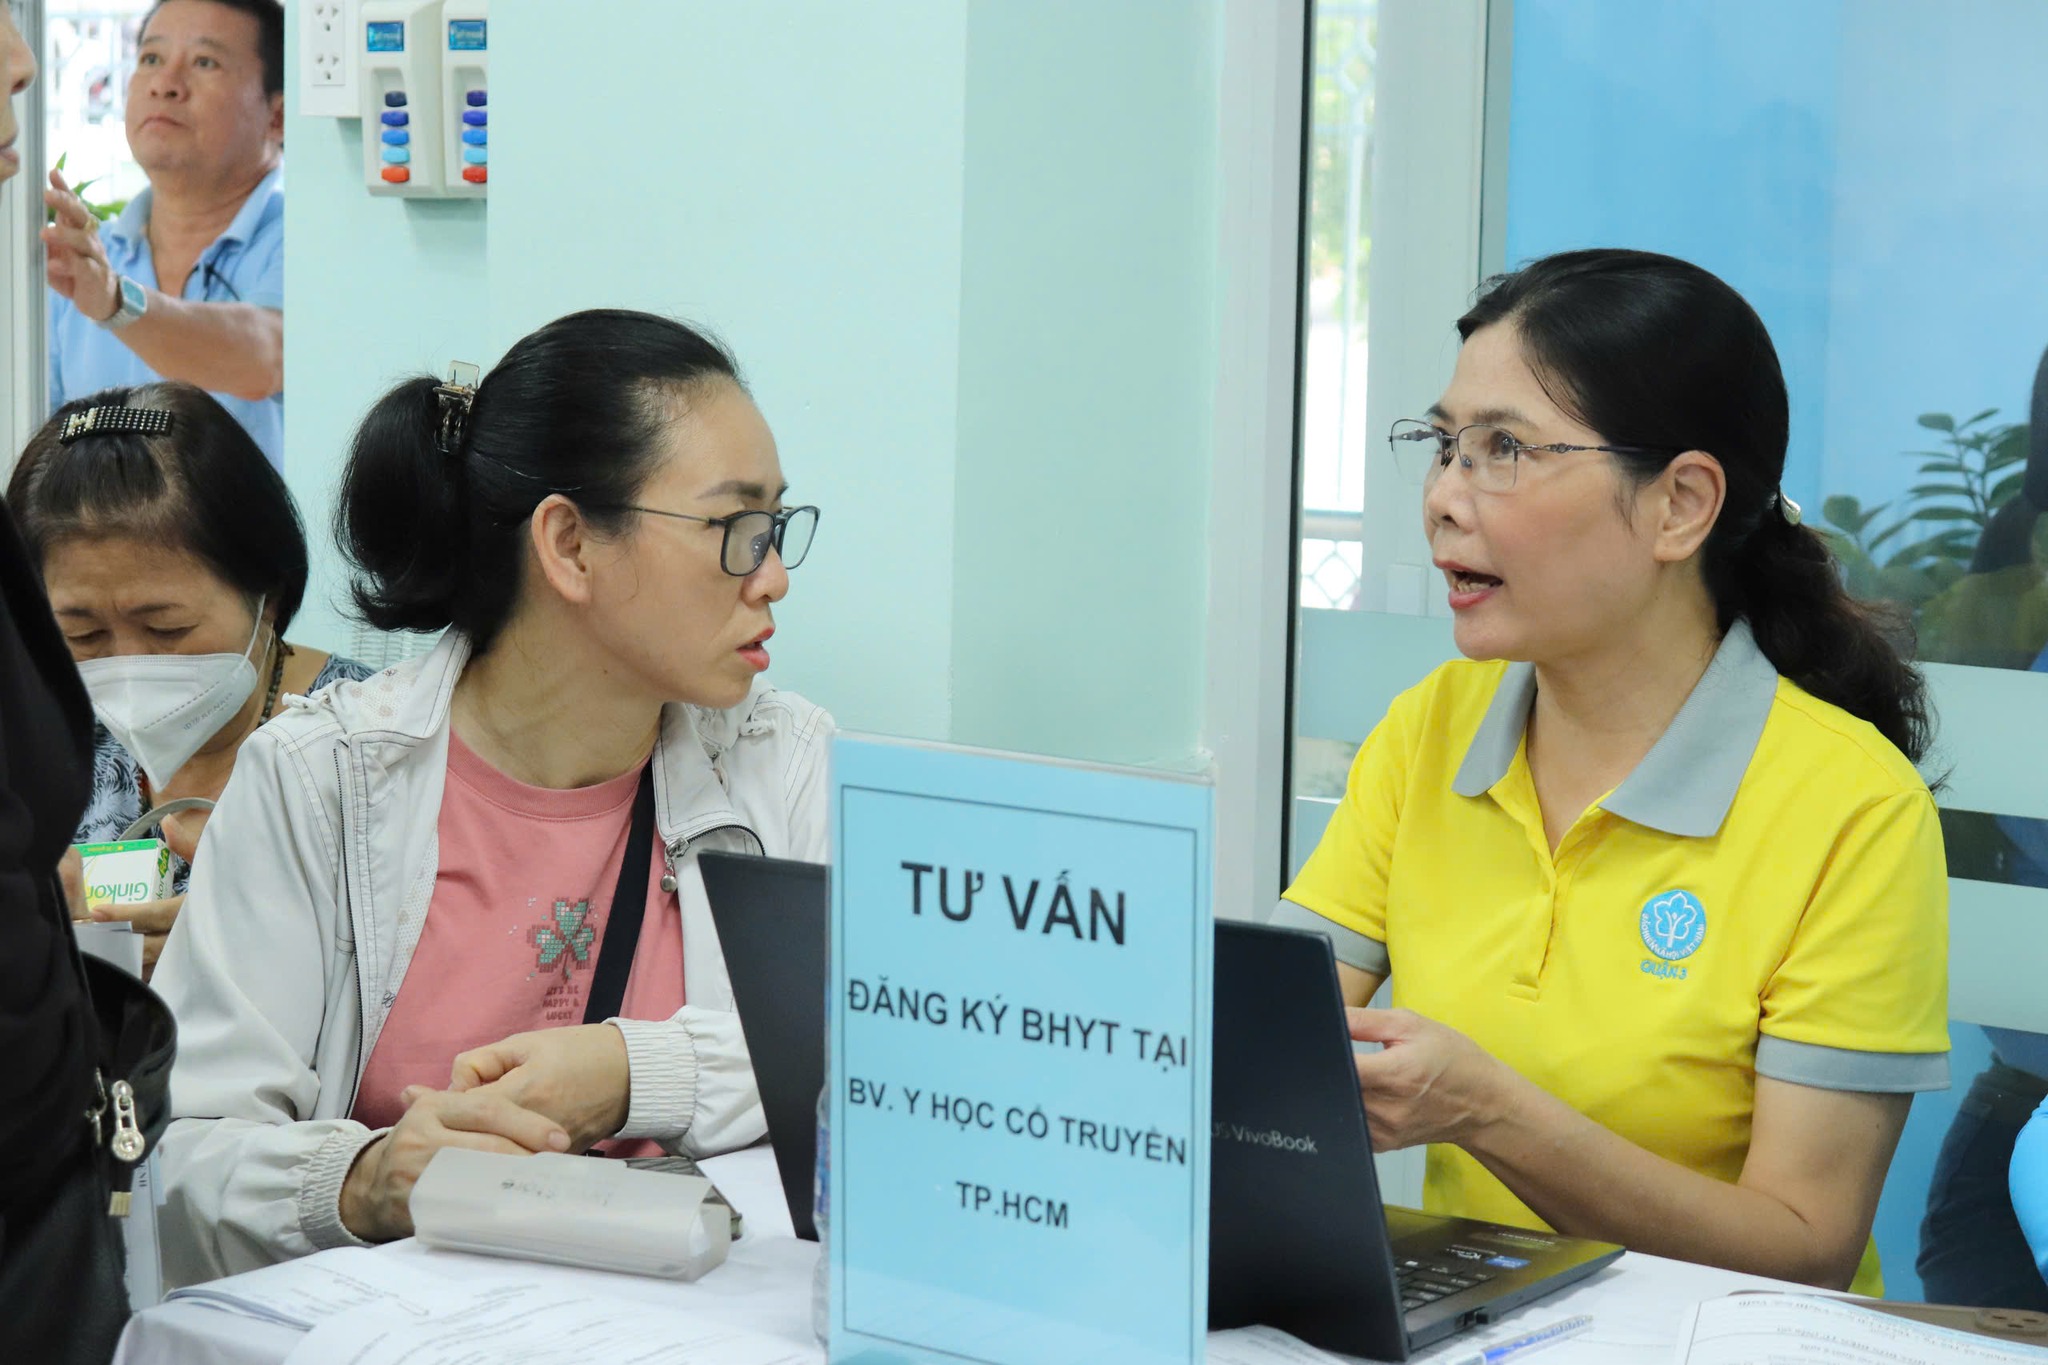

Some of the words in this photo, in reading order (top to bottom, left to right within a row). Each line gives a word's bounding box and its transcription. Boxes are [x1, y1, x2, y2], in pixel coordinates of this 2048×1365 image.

[901, 861, 984, 922] TƯ
[1002, 869, 1126, 946] VẤN
[1678, 966, 1688, 980] 3
[848, 975, 948, 1026] ĐĂNG
[961, 993, 1009, 1035] KÝ
[1022, 1008, 1120, 1055] BHYT
[1132, 1028, 1187, 1073] TẠI
[849, 1077, 894, 1112] BV.
[903, 1086, 921, 1115] Y
[931, 1093, 995, 1132] HỌC
[1231, 1123, 1318, 1153] VivoBook
[955, 1180, 1069, 1229] TP.HCM
